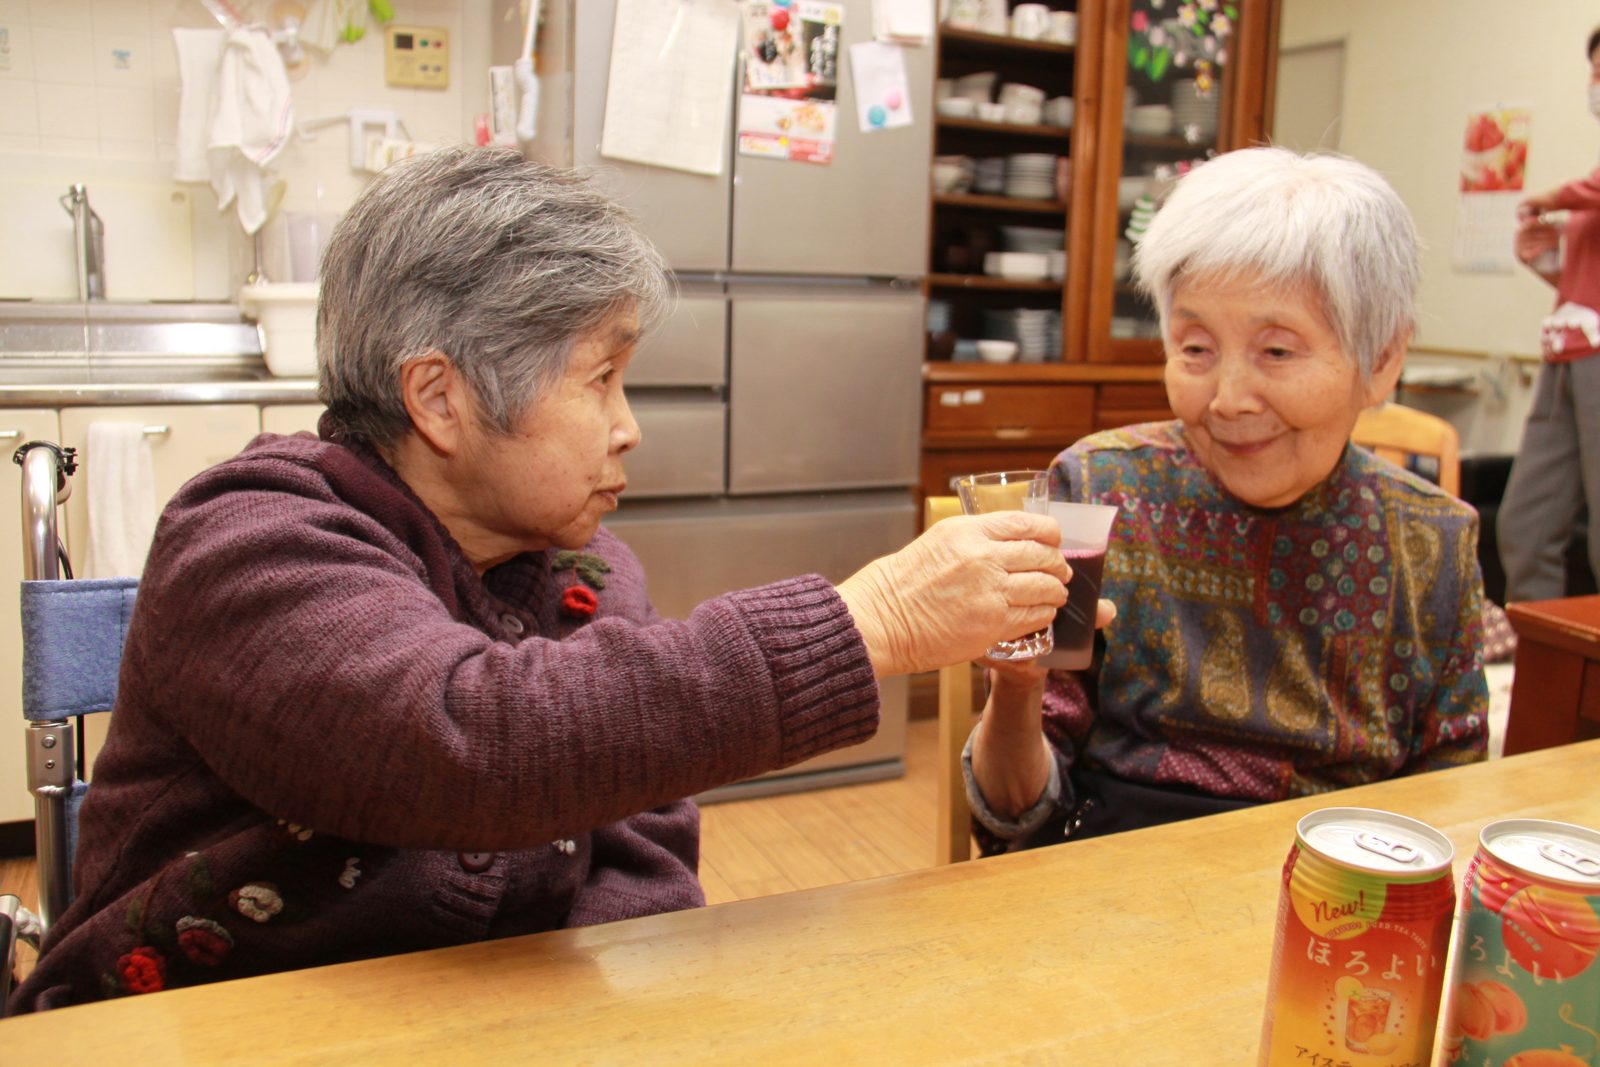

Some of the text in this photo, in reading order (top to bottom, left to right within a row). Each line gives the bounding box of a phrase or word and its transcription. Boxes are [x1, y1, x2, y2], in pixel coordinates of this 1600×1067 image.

[1310, 889, 1365, 923] New!
[1306, 936, 1436, 981] ほろよい
